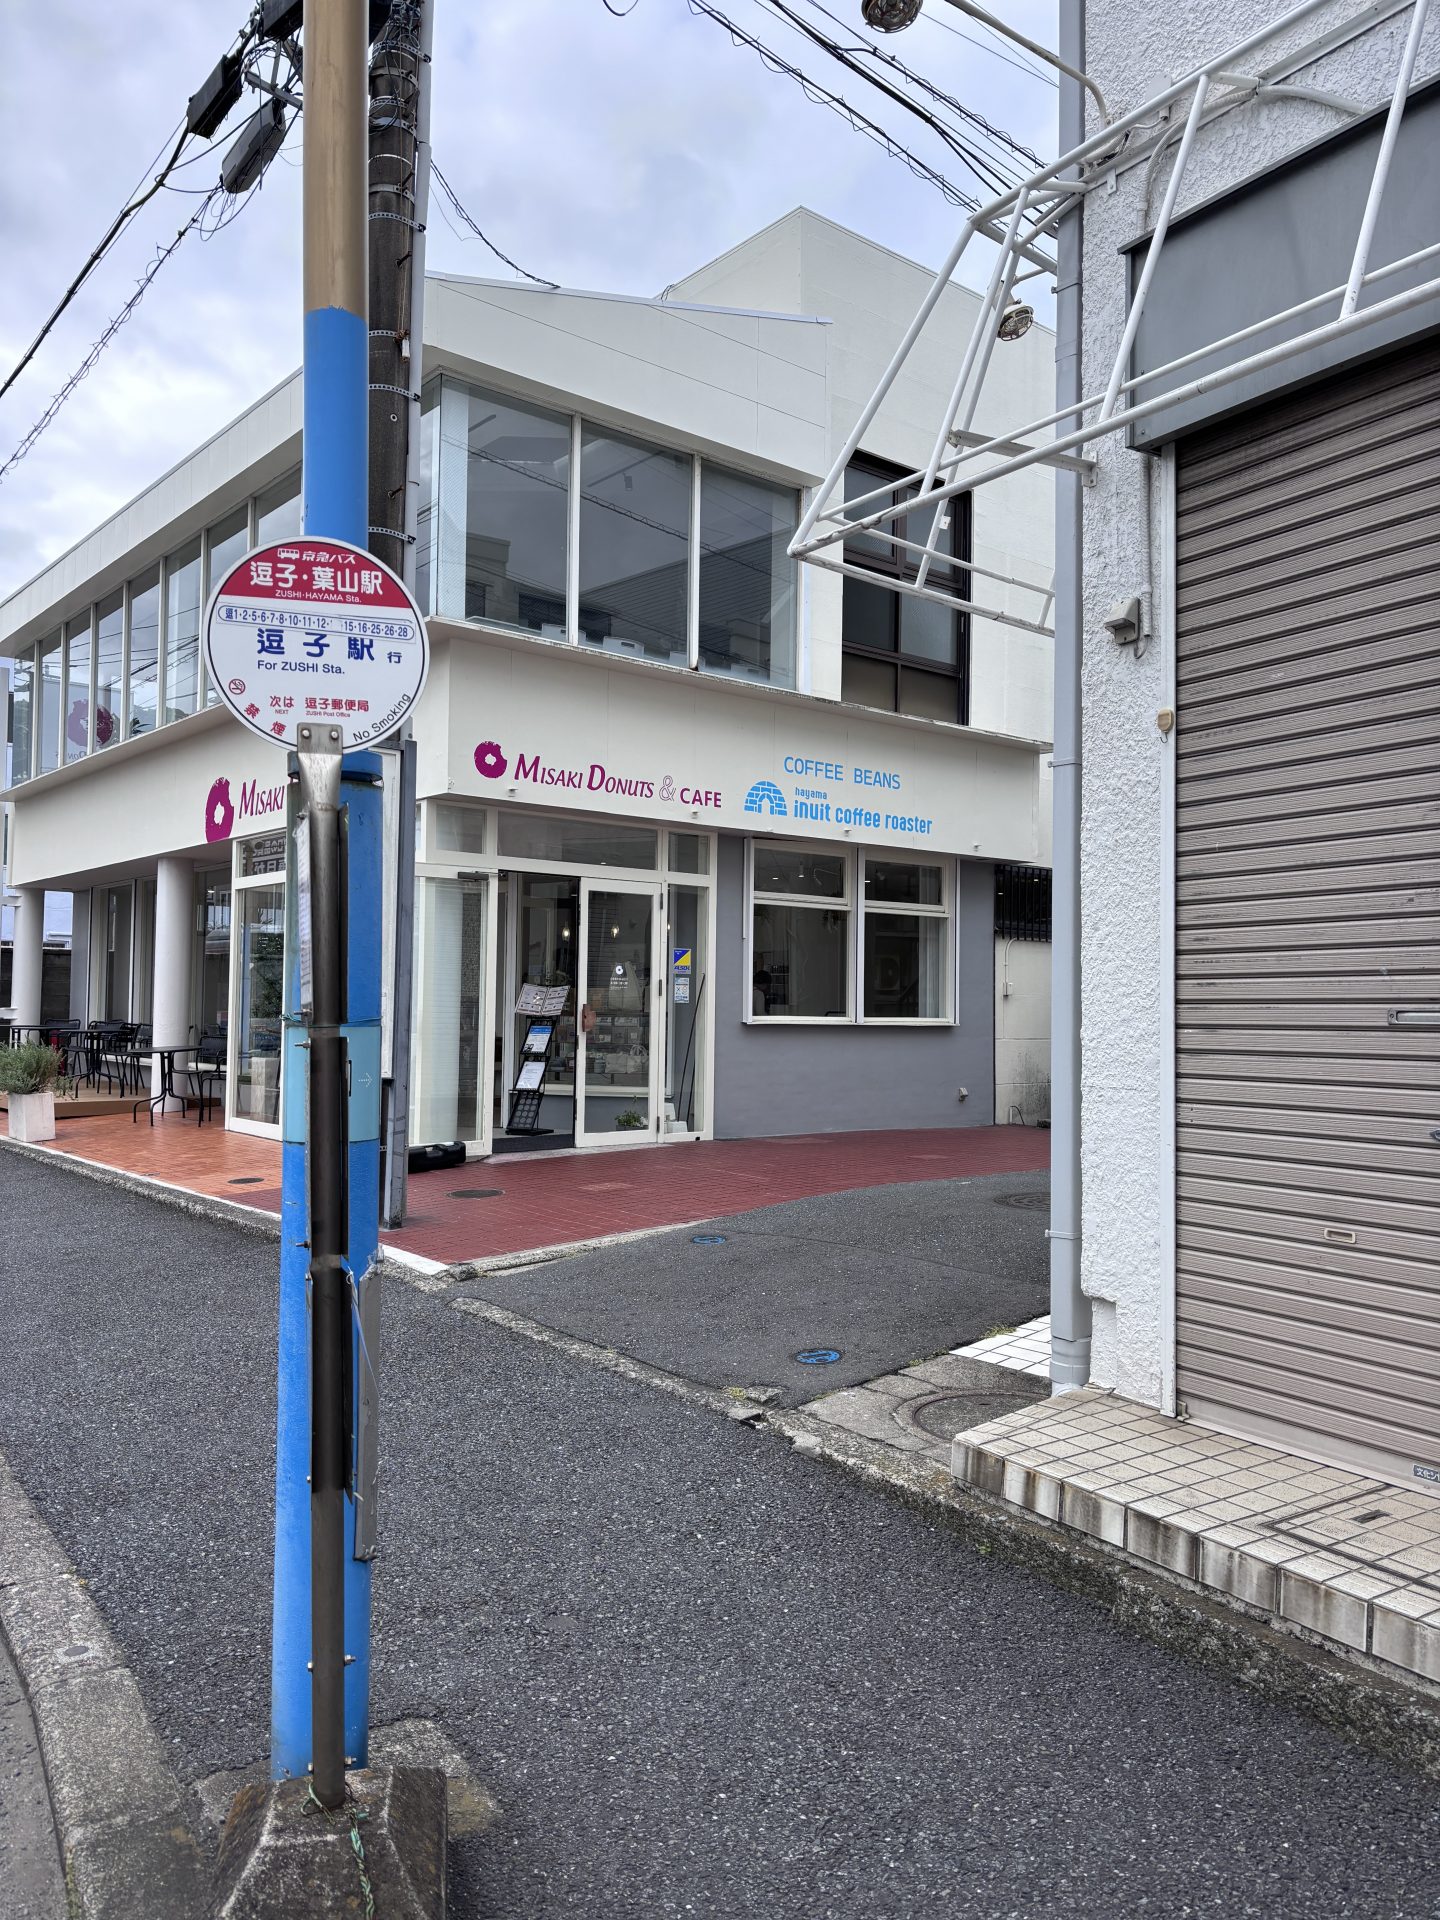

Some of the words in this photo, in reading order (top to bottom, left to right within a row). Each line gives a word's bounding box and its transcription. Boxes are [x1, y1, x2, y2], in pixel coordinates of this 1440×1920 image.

[301, 551, 356, 565] 京急バス
[250, 561, 383, 596] 逗子・葉山駅
[257, 660, 278, 671] For
[281, 661, 318, 673] ZUSHI
[322, 663, 345, 674] Sta.
[269, 695, 295, 708] 次は
[304, 697, 369, 713] 逗子郵便局
[352, 730, 371, 742] No
[371, 693, 412, 733] Smoking
[514, 753, 583, 789] MISAKI
[586, 764, 655, 799] DONUTS
[658, 774, 677, 802] &
[679, 787, 722, 808] CAFE
[783, 756, 844, 781] COFFEE
[853, 767, 901, 790] BEANS
[238, 779, 286, 819] MISAKI
[795, 786, 828, 800] hayama
[793, 800, 831, 822] inuit
[835, 807, 881, 828] coffee
[884, 813, 933, 835] roaster
